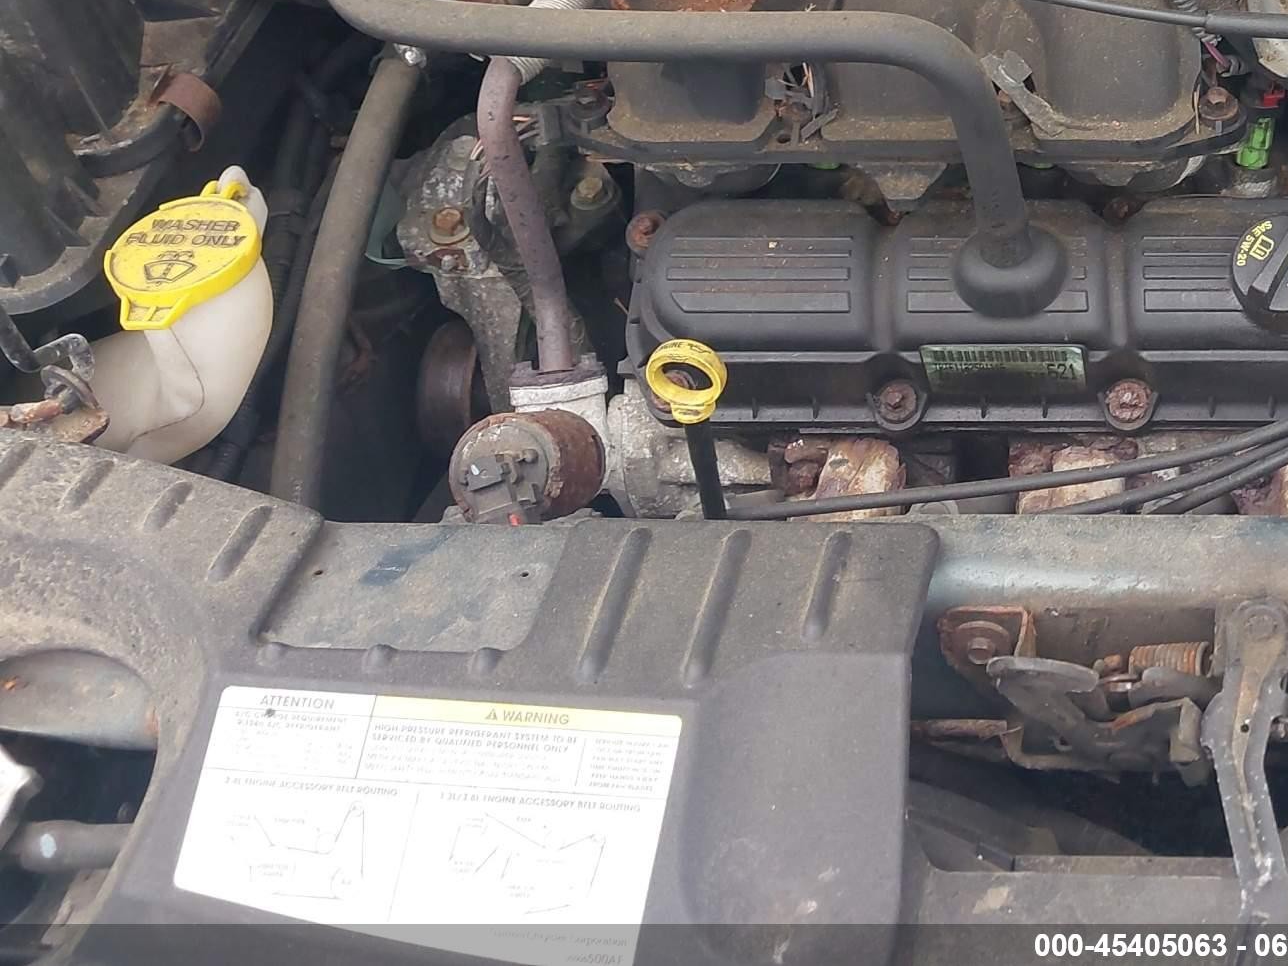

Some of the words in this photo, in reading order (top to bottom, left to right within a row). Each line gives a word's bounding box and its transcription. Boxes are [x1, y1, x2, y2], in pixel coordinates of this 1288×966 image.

[151, 219, 241, 232] WASHER
[1252, 220, 1274, 238] SAE
[125, 233, 186, 246] FLUID
[191, 234, 247, 247] ONLY
[1236, 233, 1256, 267] 5W-20
[260, 695, 335, 709] ATTENTION
[503, 709, 570, 725] WARNING
[570, 932, 628, 946] orporation
